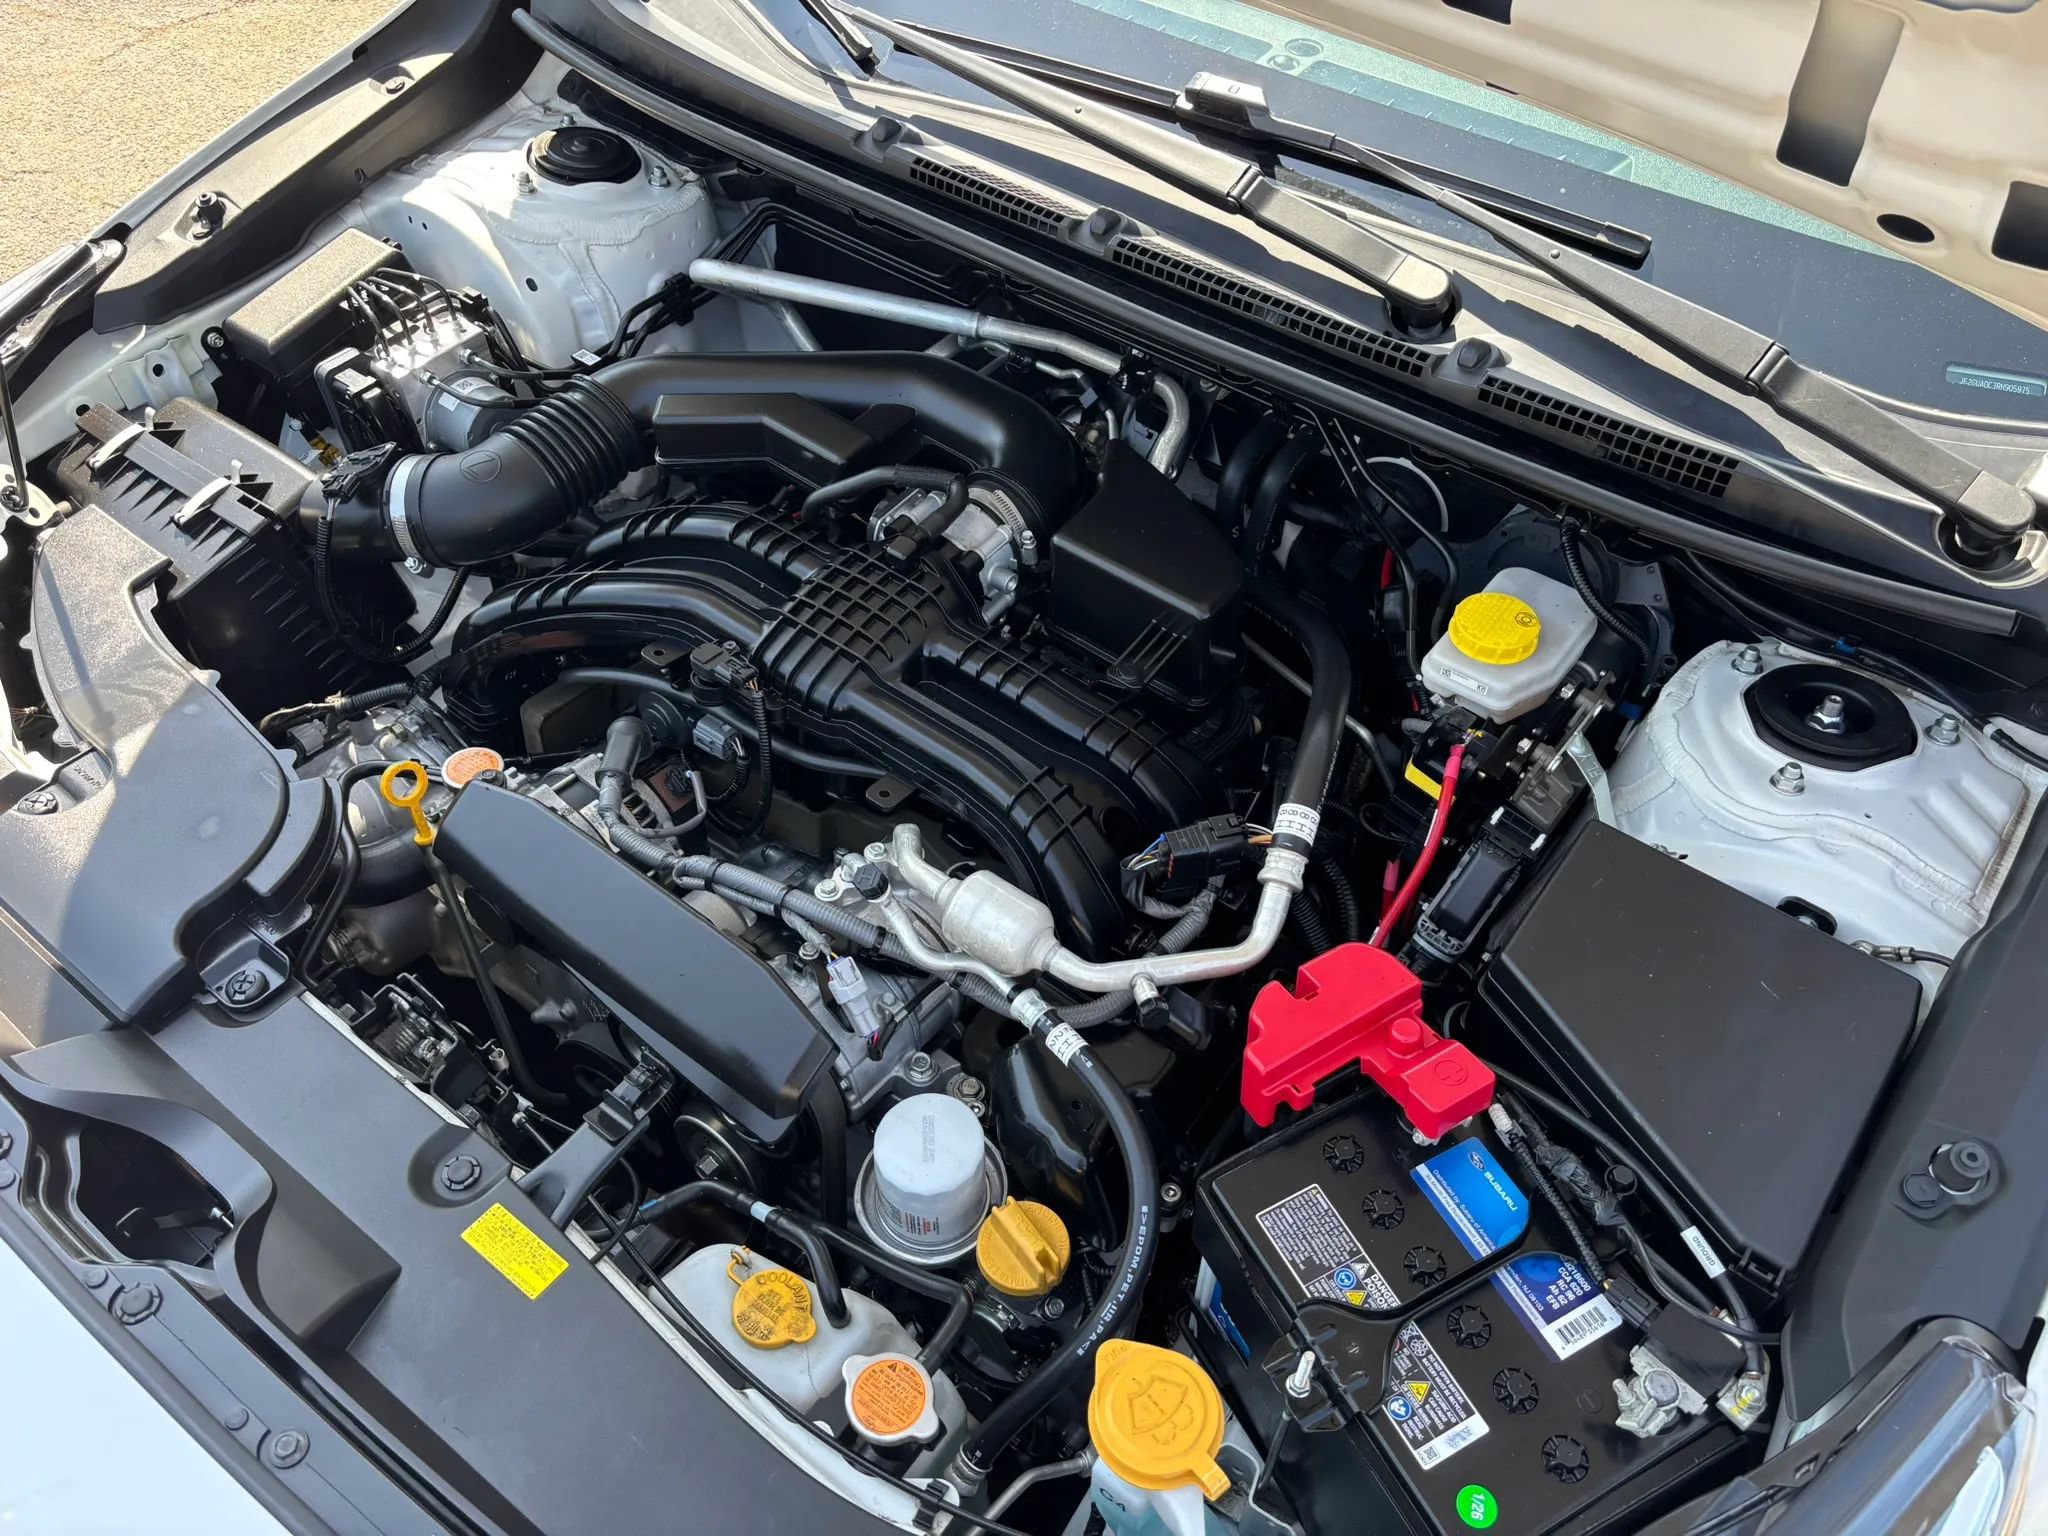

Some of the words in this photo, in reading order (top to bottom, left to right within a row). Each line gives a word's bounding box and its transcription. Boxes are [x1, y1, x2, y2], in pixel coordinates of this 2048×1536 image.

[1432, 1168, 1455, 1196] Distributed
[1452, 1195, 1460, 1204] by
[1459, 1203, 1476, 1223] Subaru
[1472, 1221, 1480, 1229] of
[1483, 1170, 1517, 1212] SUBARU
[1450, 1206, 1476, 1239] Replacement
[1691, 1234, 1716, 1266] GROUND
[1522, 1284, 1531, 1294] NJ
[1556, 1278, 1567, 1291] RC
[1564, 1289, 1575, 1301] 96
[1557, 1266, 1572, 1282] CCA
[1569, 1280, 1583, 1296] 620
[1564, 1259, 1591, 1292] 821B600
[755, 1271, 808, 1312] COOLANT
[1363, 1277, 1389, 1311] POISON
[1545, 1294, 1559, 1310] EFB
[1548, 1283, 1560, 1295] Ah
[1556, 1293, 1567, 1305] 62
[1421, 1356, 1437, 1378] BATTERY
[1434, 1375, 1446, 1390] MUST
[1443, 1388, 1451, 1396] BE
[1427, 1353, 1435, 1362] DO
[1432, 1360, 1442, 1371] NOT
[1439, 1369, 1450, 1384] OPEN
[1405, 1390, 1420, 1408] SEVERE
[1427, 1396, 1438, 1408] CAN
[1434, 1406, 1448, 1422] CAUSE
[1412, 1415, 1424, 1429] READ
[1424, 1403, 1444, 1430] BLINDNESS
[1470, 1493, 1485, 1520] 1/26
